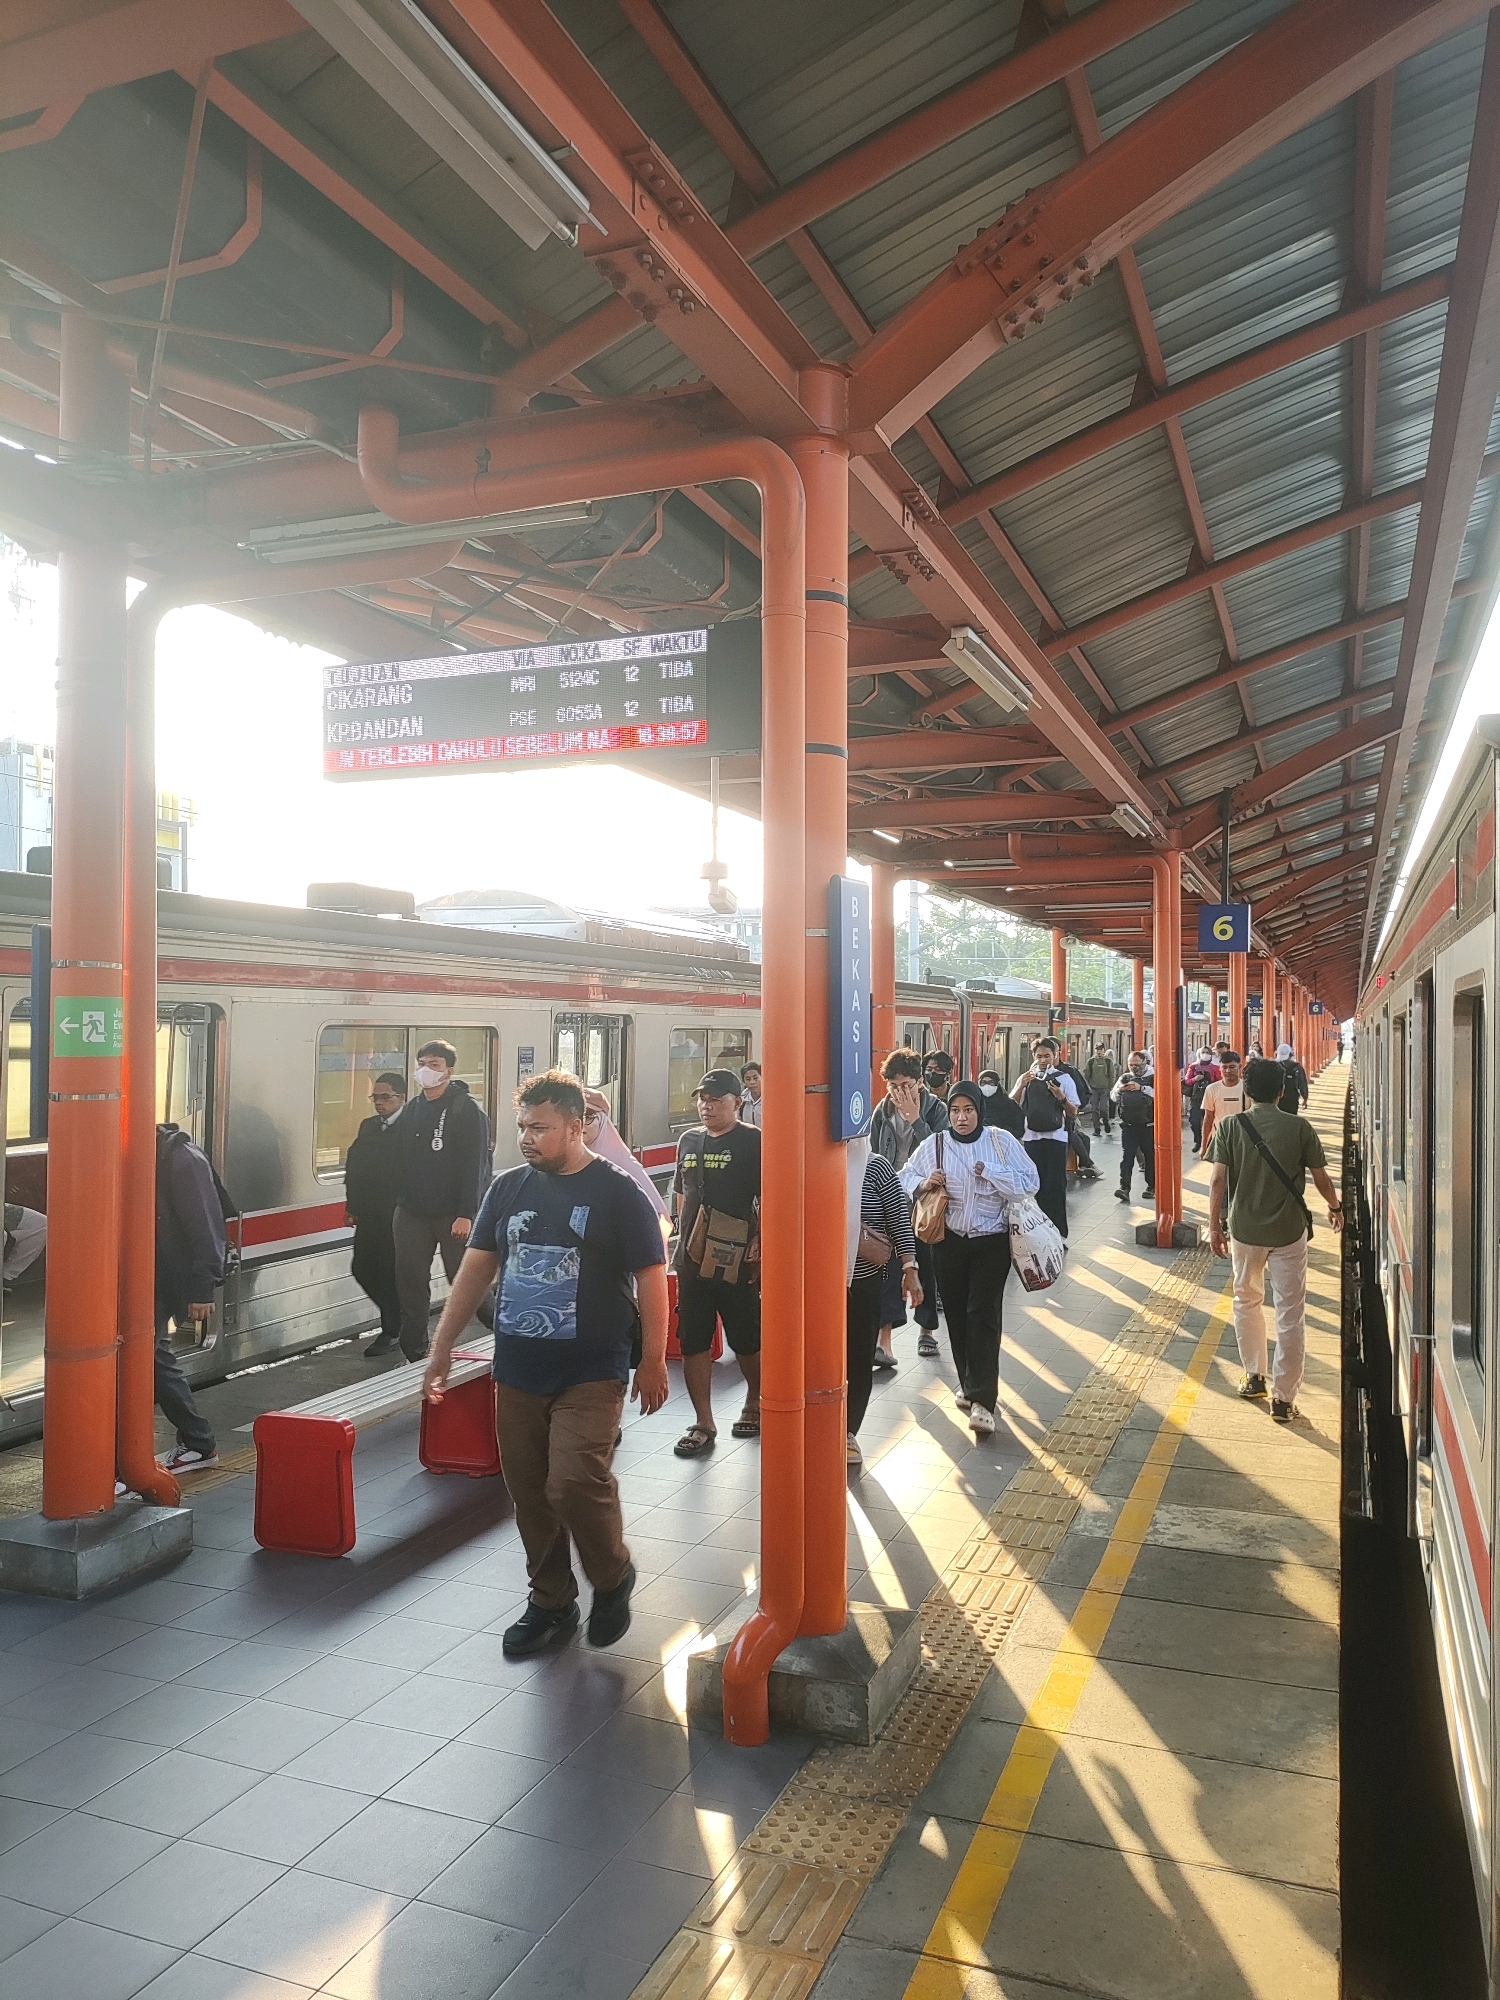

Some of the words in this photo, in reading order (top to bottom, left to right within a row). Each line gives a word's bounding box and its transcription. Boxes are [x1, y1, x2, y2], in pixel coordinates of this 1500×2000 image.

[330, 662, 400, 685] TUJUAN
[513, 650, 536, 668] VIA
[623, 639, 643, 656] SF
[650, 631, 702, 652] WAKTU
[326, 683, 413, 711] CIKARANG
[624, 664, 640, 682] 12
[658, 659, 694, 679] TIBA
[509, 708, 537, 727] PSE
[624, 700, 640, 717] 12
[658, 695, 694, 714] TIBA
[359, 743, 433, 766] TERLEBIH
[438, 738, 503, 761] DAHULU
[505, 732, 583, 756] SEBELUM
[1212, 915, 1234, 941] 6
[851, 896, 860, 1074] BEKASI
[1052, 1006, 1062, 1019] 7
[1194, 1003, 1201, 1012] 7
[1312, 1004, 1320, 1013] 6
